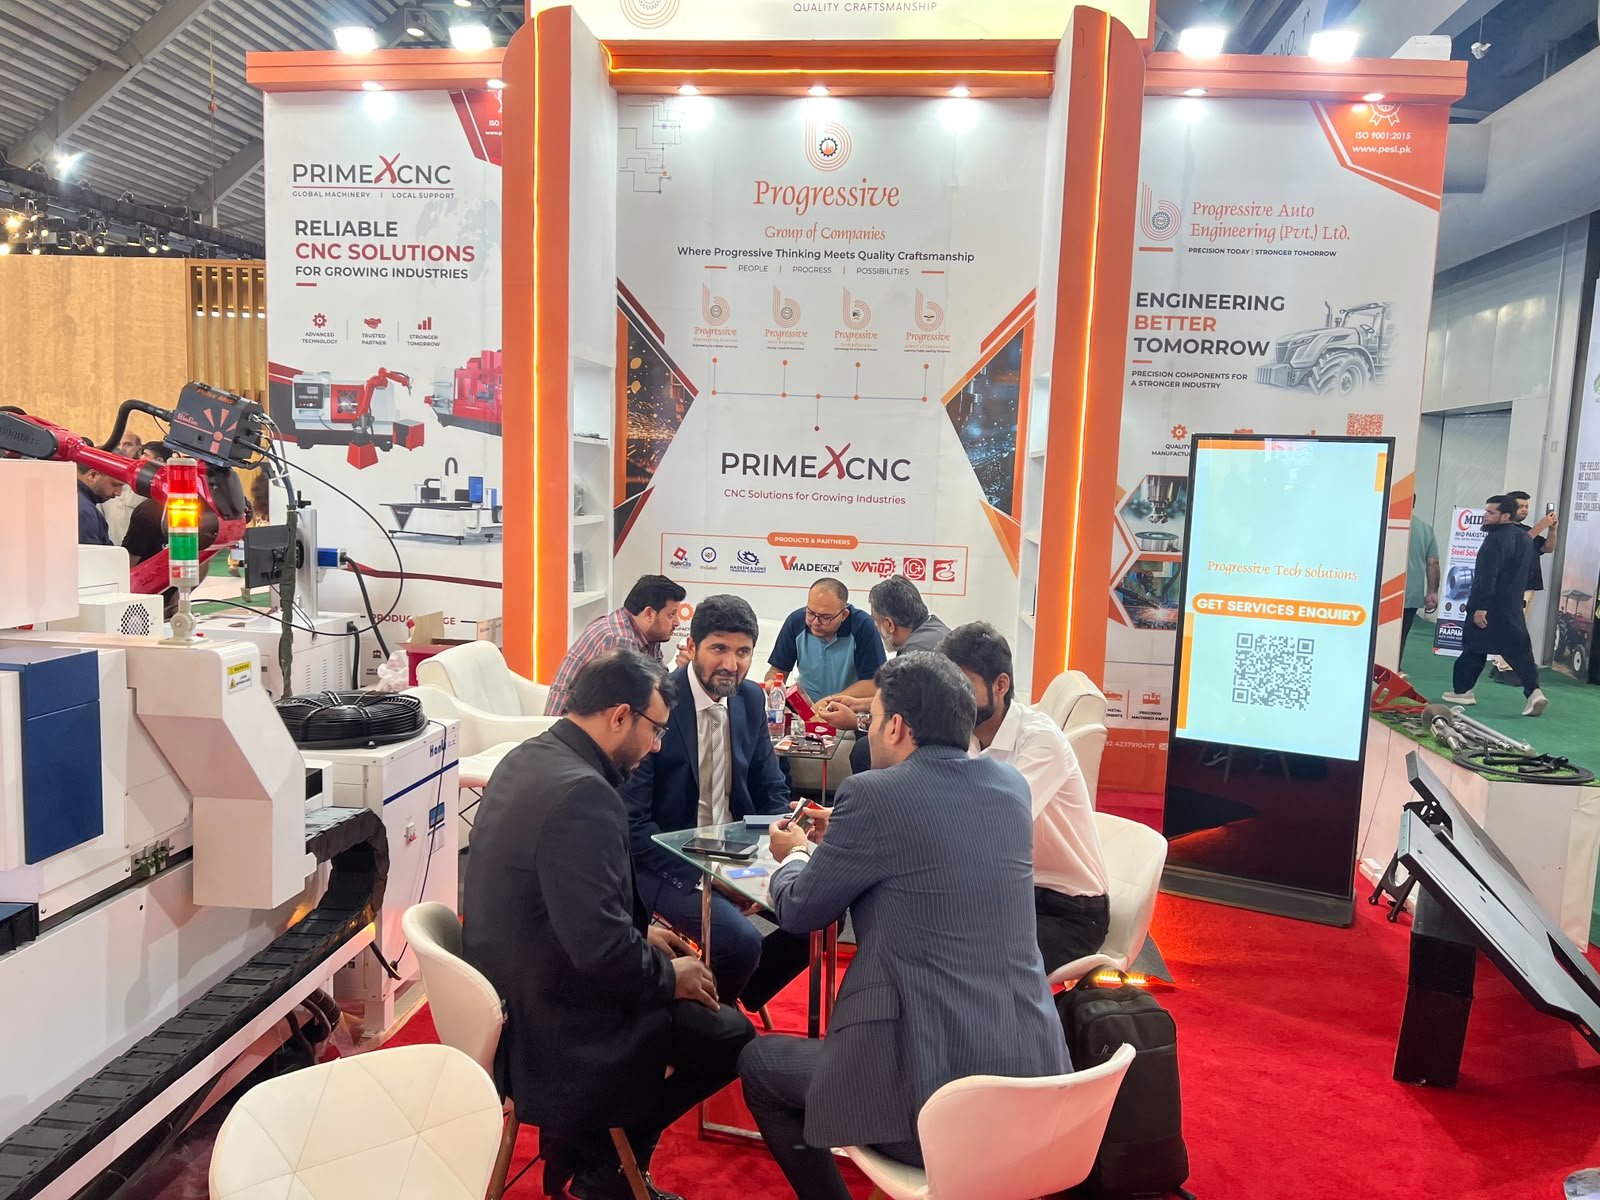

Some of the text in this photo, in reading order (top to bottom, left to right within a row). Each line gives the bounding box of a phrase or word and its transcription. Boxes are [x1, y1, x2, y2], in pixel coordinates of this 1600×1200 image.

[793, 2, 937, 12] QUALITY CRAFTSMANSHIP
[1355, 131, 1411, 140] ISO 9001:2015
[325, 191, 371, 199] MACHINERY
[753, 177, 900, 216] Progressive
[1191, 201, 1315, 221] Progressive Auto
[295, 220, 398, 237] RELIABLE
[765, 222, 886, 244] Group of Companies
[1190, 222, 1350, 243] Engineering (Pvt.) Ltd.
[295, 243, 475, 263] CNC SOLUTIONS
[677, 246, 975, 263] Where Progressive Thinking Meets Quality Craftsmanship
[295, 266, 469, 279] FOR GROWING INDUSTRIES
[738, 265, 768, 273] PEOPLE
[792, 266, 832, 274] PROGRESS
[856, 267, 910, 275] POSSIBILITIES
[1136, 292, 1285, 311] ENGINEERING
[1134, 314, 1217, 332] BETTER
[1133, 337, 1270, 356] TOMORROW
[1131, 370, 1173, 378] PRECISION
[1175, 371, 1230, 380] COMPONENTS
[1138, 380, 1181, 388] STRONGER
[1182, 381, 1221, 389] INDUSTRY
[724, 489, 906, 505] CNC Solutions for Growing Industries
[774, 536, 810, 544] PRODUCTS
[817, 538, 851, 546] PARTNERS
[1207, 560, 1358, 581] Progressive Tech Solutions
[1196, 598, 1362, 622] GET SERVICES ENQUIRY
